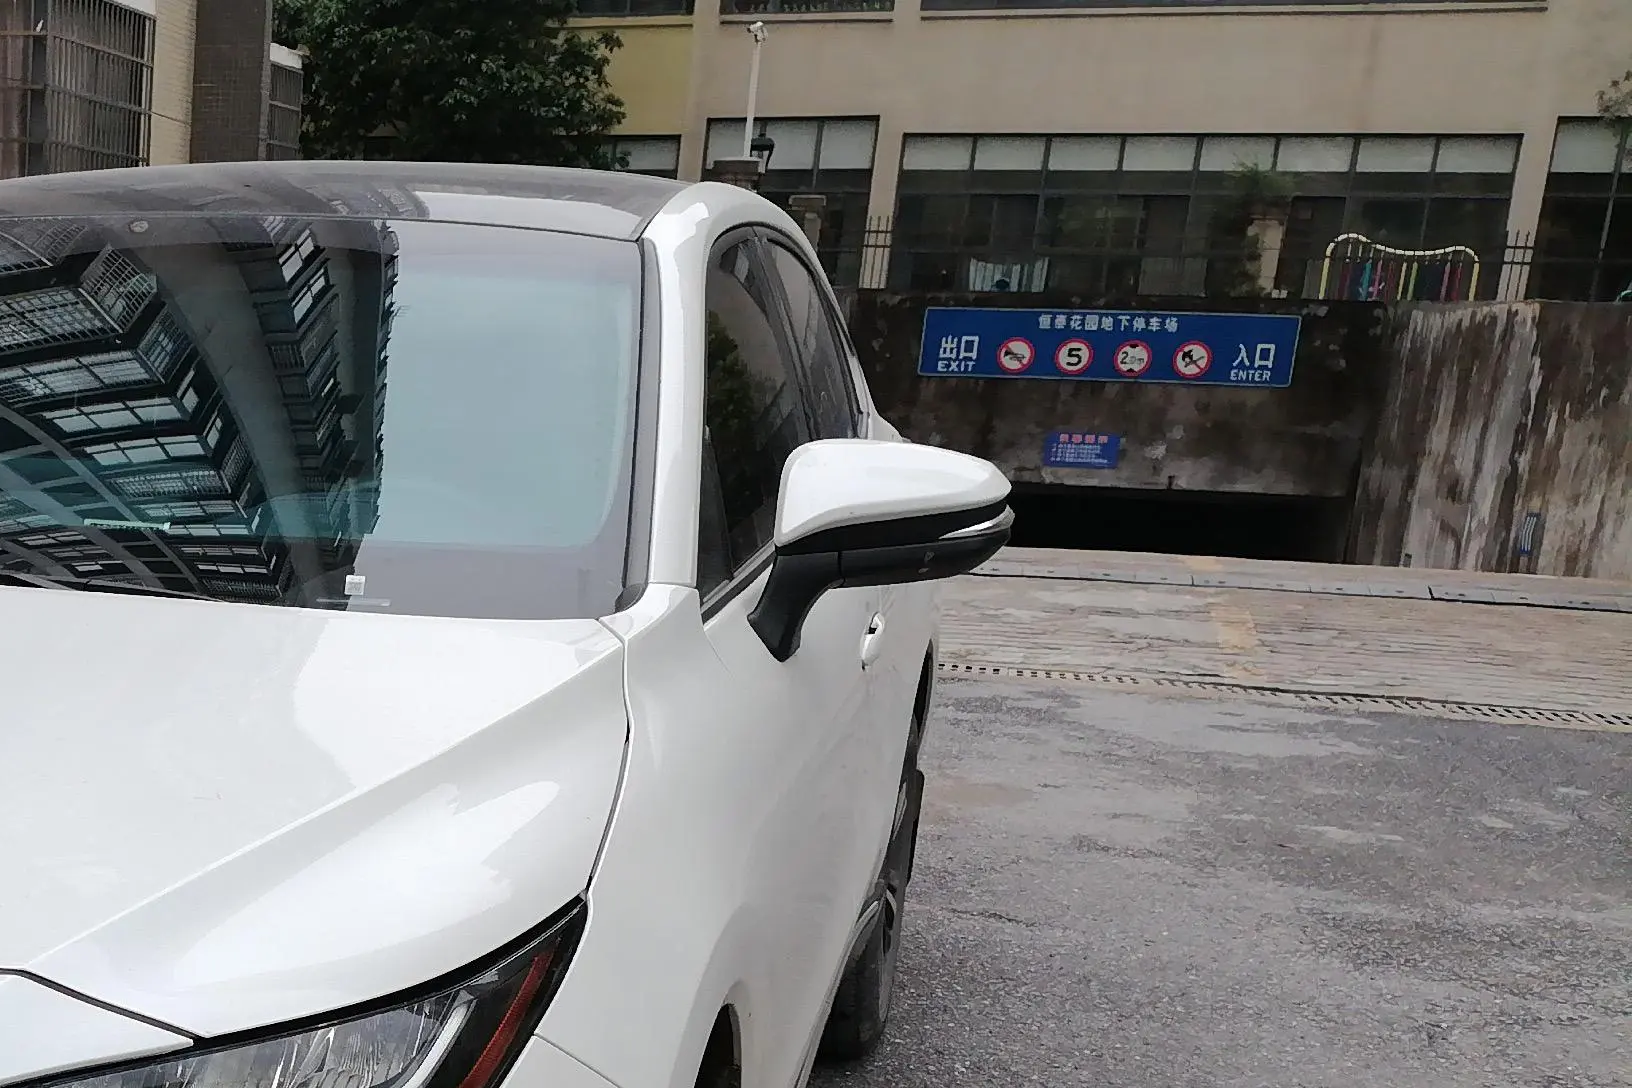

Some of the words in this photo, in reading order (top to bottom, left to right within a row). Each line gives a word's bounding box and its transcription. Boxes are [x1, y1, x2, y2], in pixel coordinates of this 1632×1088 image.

[938, 334, 979, 360] 出口
[1066, 347, 1083, 367] 5
[1232, 343, 1276, 368] 入口
[937, 360, 976, 372] EXIT
[1230, 369, 1271, 382] ENTER
